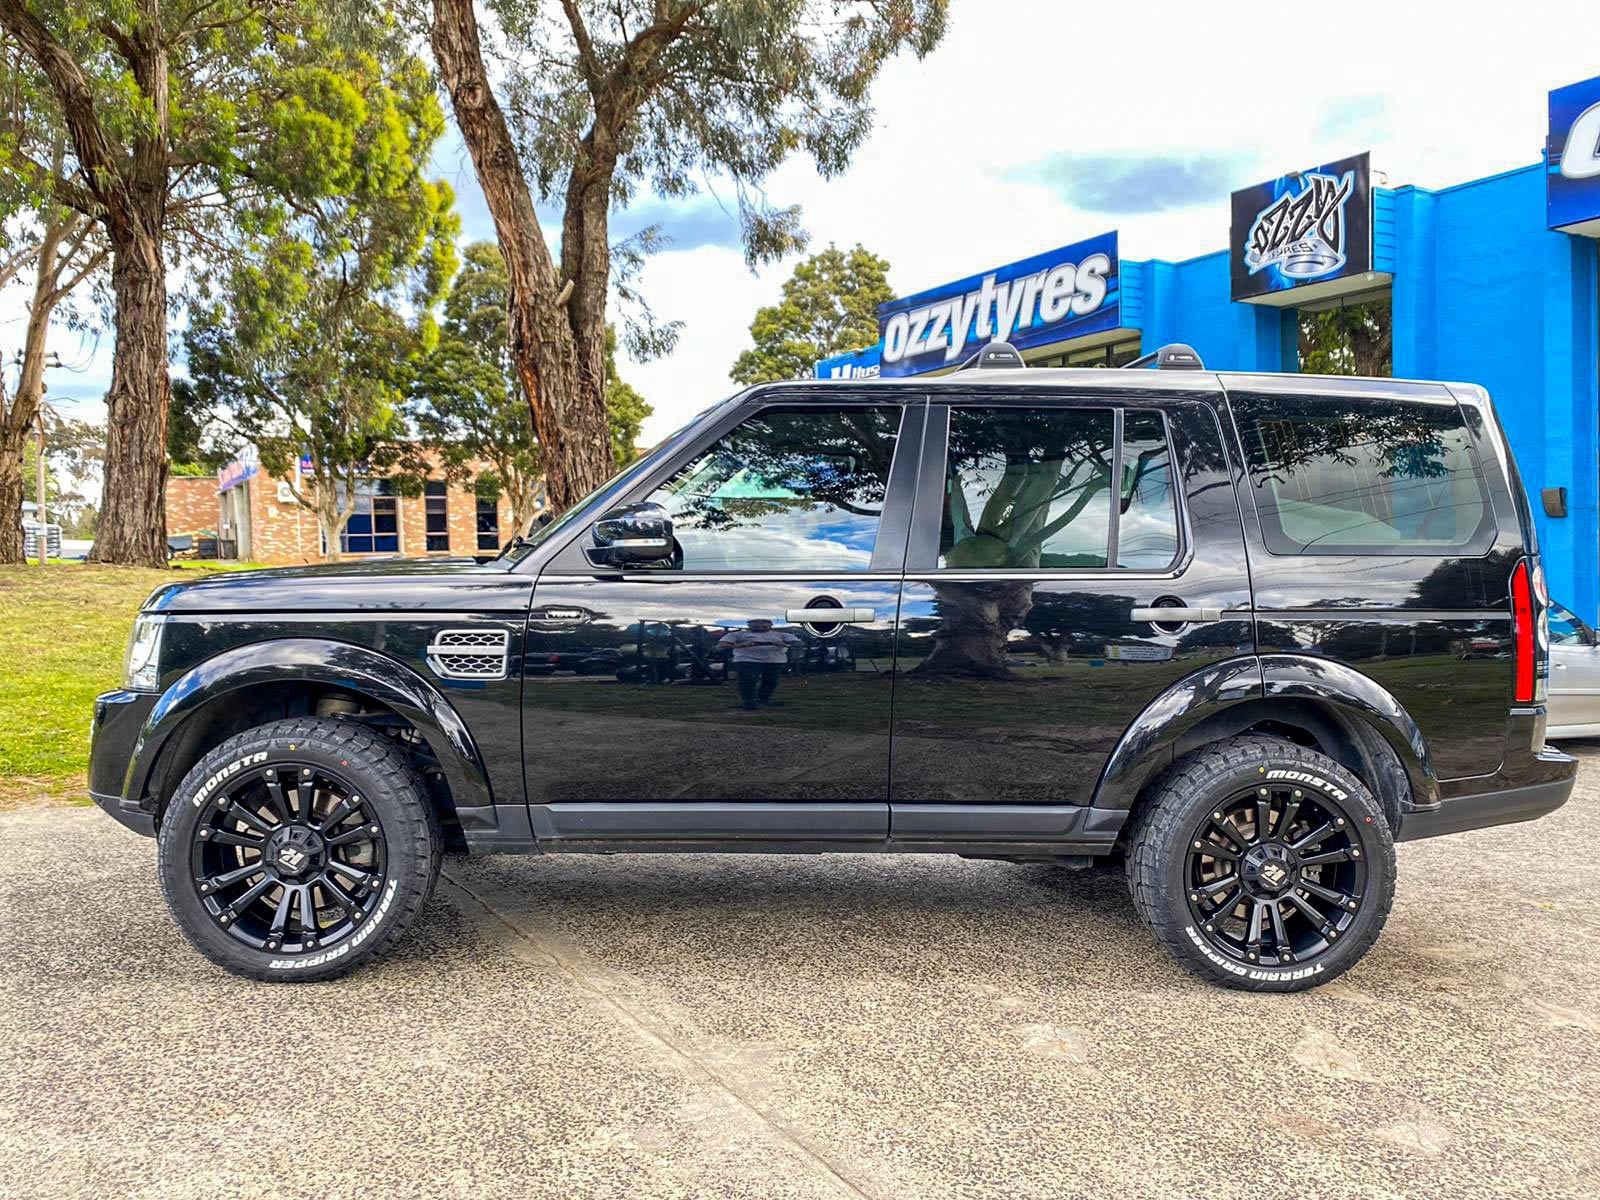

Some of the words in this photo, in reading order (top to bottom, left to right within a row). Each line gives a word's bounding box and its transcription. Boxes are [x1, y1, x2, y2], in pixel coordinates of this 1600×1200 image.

[883, 252, 1111, 363] ozzytyres
[192, 751, 268, 807] MONSTA
[1266, 769, 1348, 801] MONSTA
[351, 879, 398, 947] TERRAIN
[268, 943, 349, 969] GRIPPER
[1185, 925, 1248, 976] GRIPPER
[1248, 963, 1325, 981] TERRAIN
